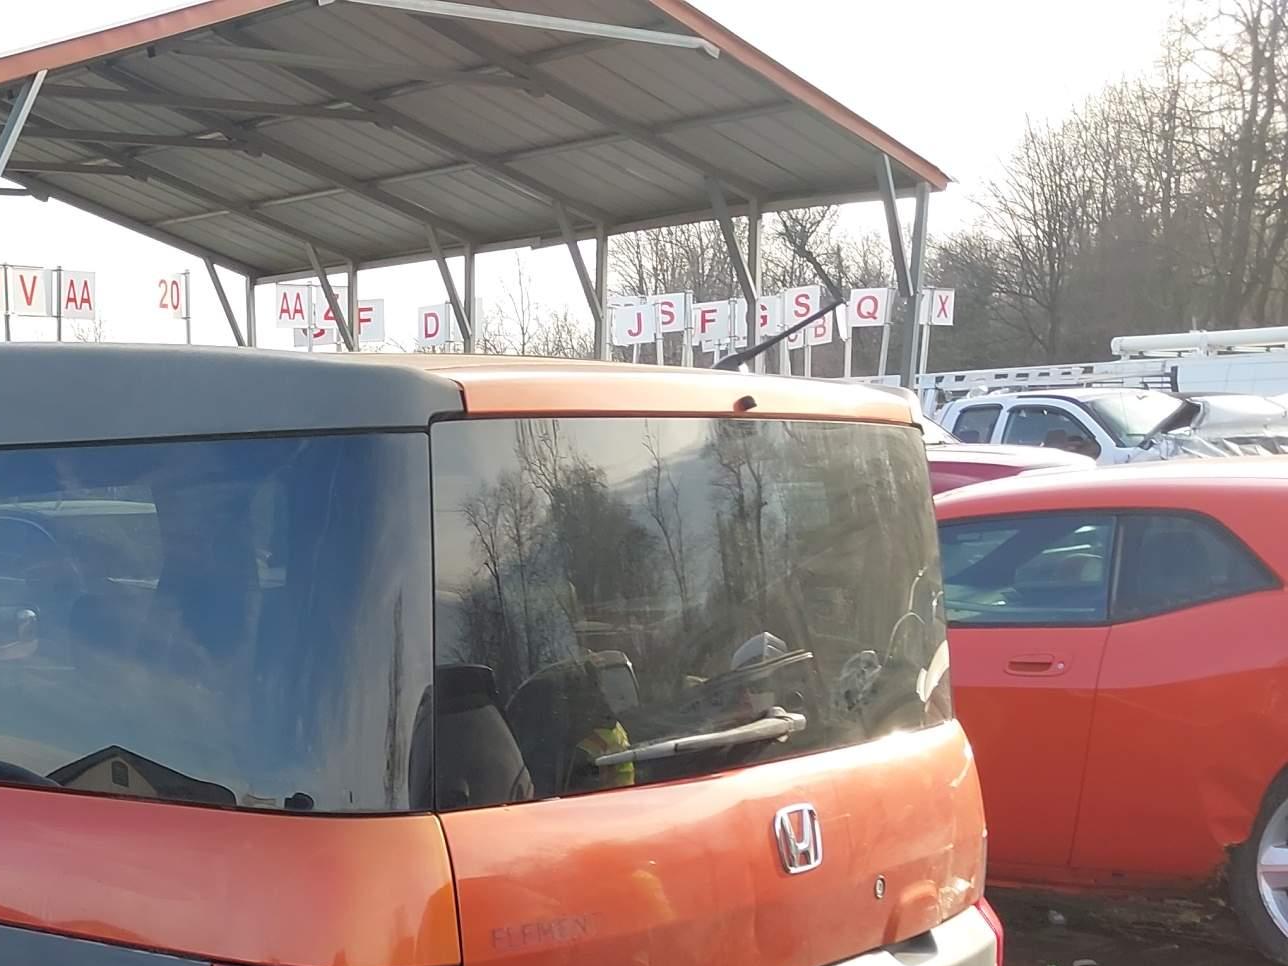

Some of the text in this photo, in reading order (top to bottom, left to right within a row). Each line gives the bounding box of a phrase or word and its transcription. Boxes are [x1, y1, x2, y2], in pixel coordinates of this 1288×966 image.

[18, 274, 38, 307] V
[64, 279, 93, 311] AA
[158, 278, 180, 311] 20
[278, 292, 305, 321] AA
[660, 301, 675, 326] S
[793, 293, 810, 318] S
[856, 295, 879, 320] Q
[936, 294, 949, 319] X
[423, 312, 440, 339] D
[627, 312, 643, 337] J
[700, 308, 718, 334] F
